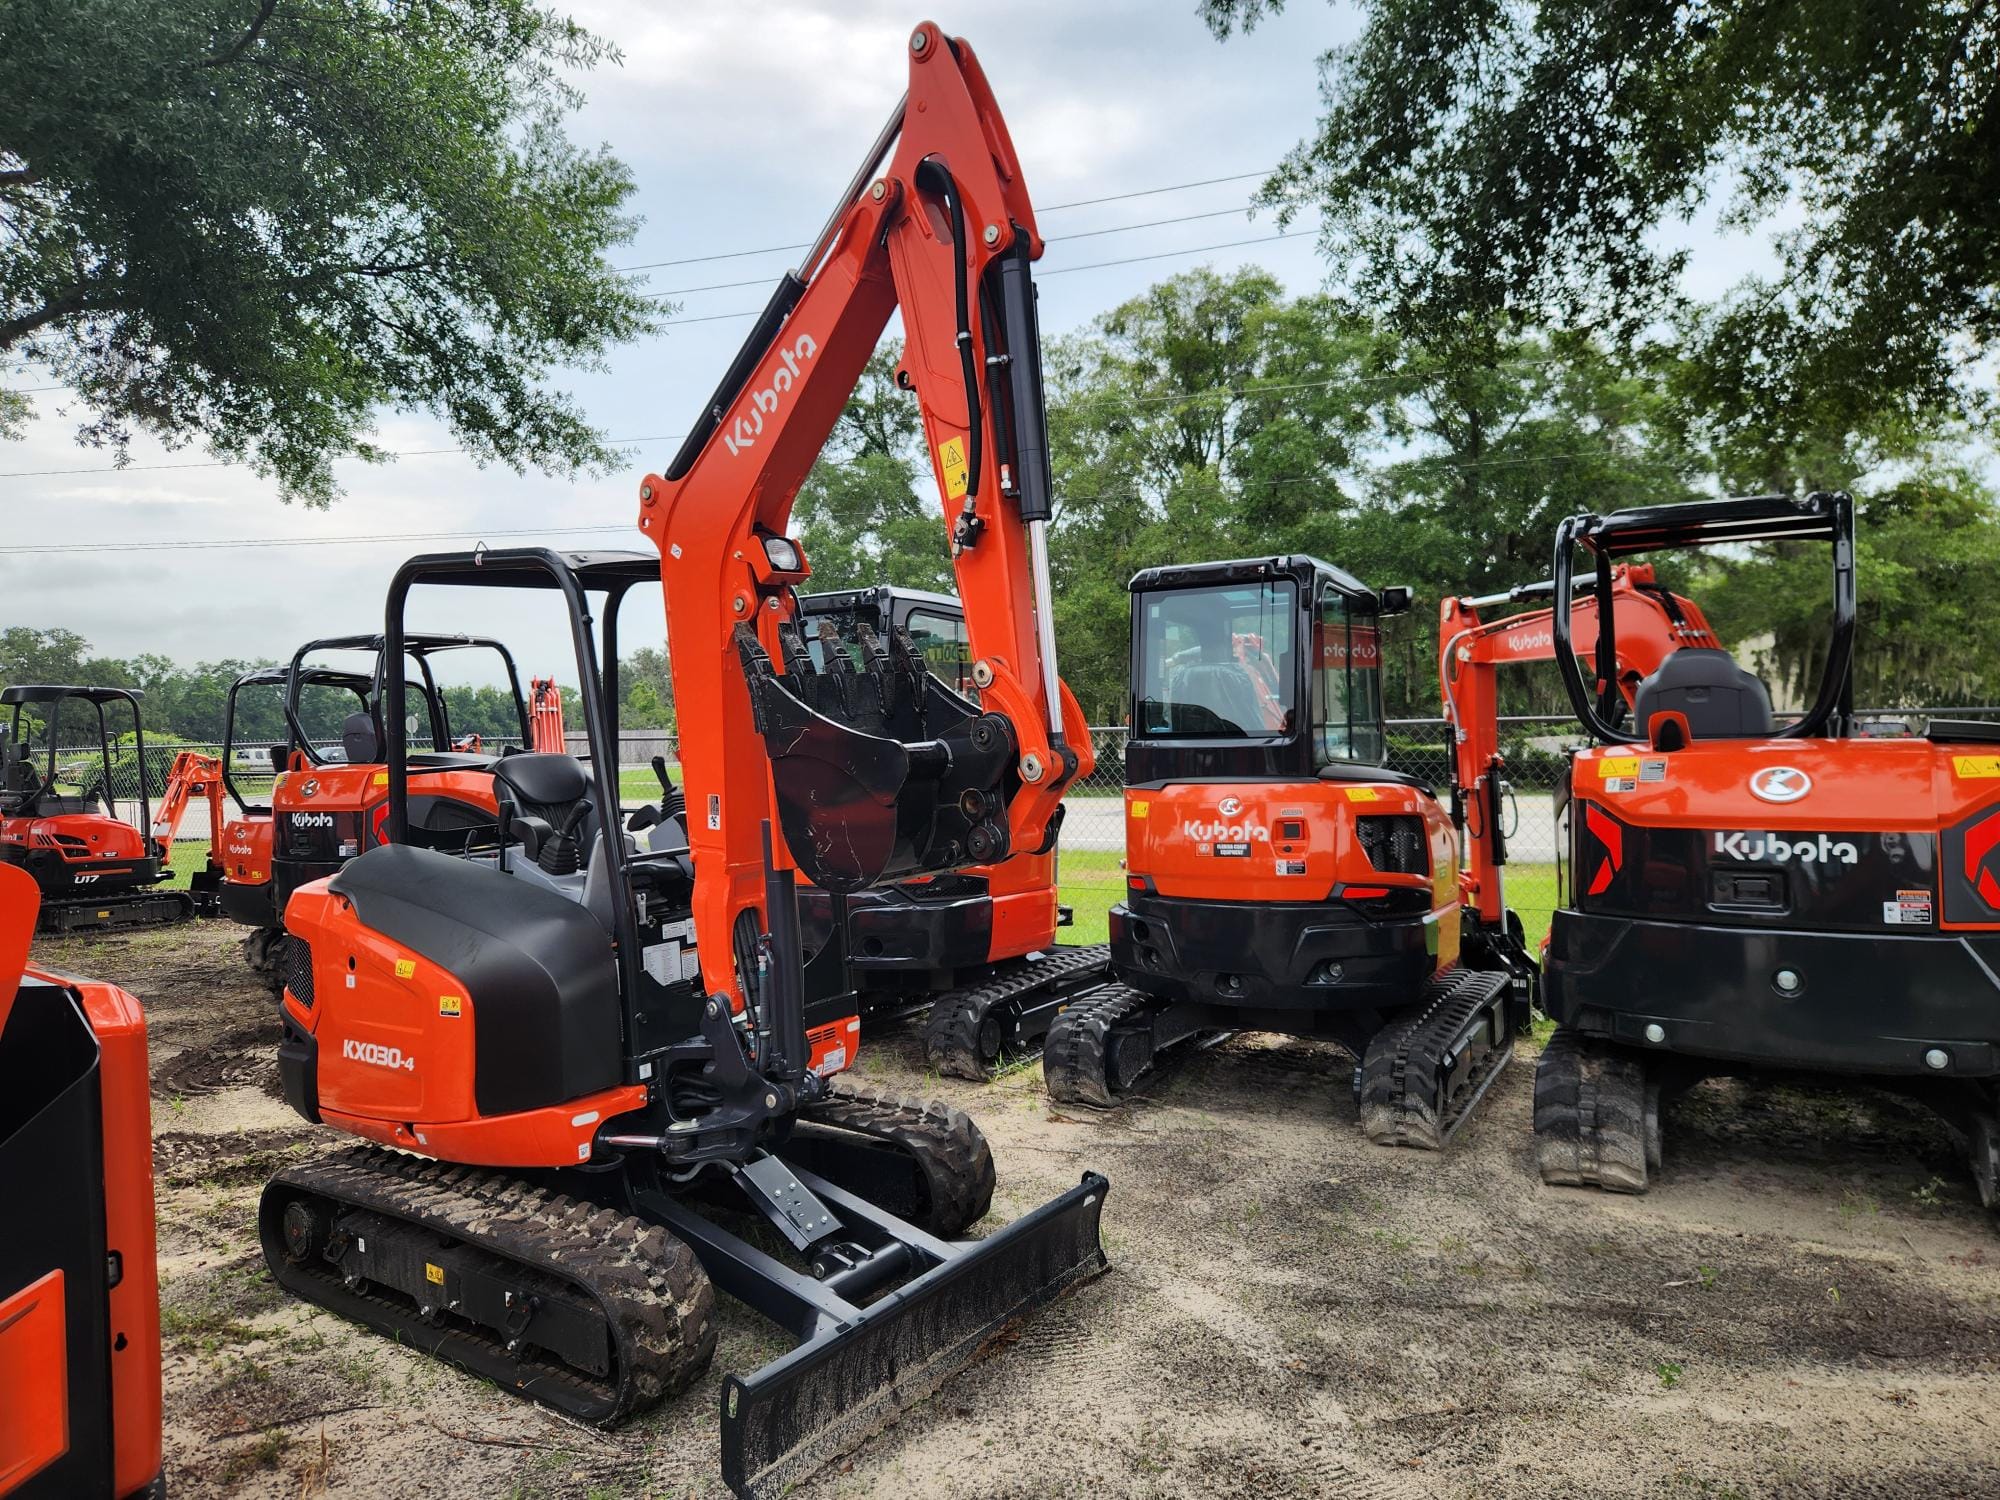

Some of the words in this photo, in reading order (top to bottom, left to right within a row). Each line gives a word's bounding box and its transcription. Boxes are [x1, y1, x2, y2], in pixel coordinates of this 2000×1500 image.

[725, 334, 817, 457] Kubota
[1508, 631, 1552, 652] Kubota
[291, 812, 333, 827] Kubota
[1184, 820, 1269, 842] Kubota
[229, 844, 252, 855] Kubota
[1714, 831, 1858, 864] Kubota
[74, 875, 100, 884] U17
[343, 1039, 415, 1072] KX030-4
